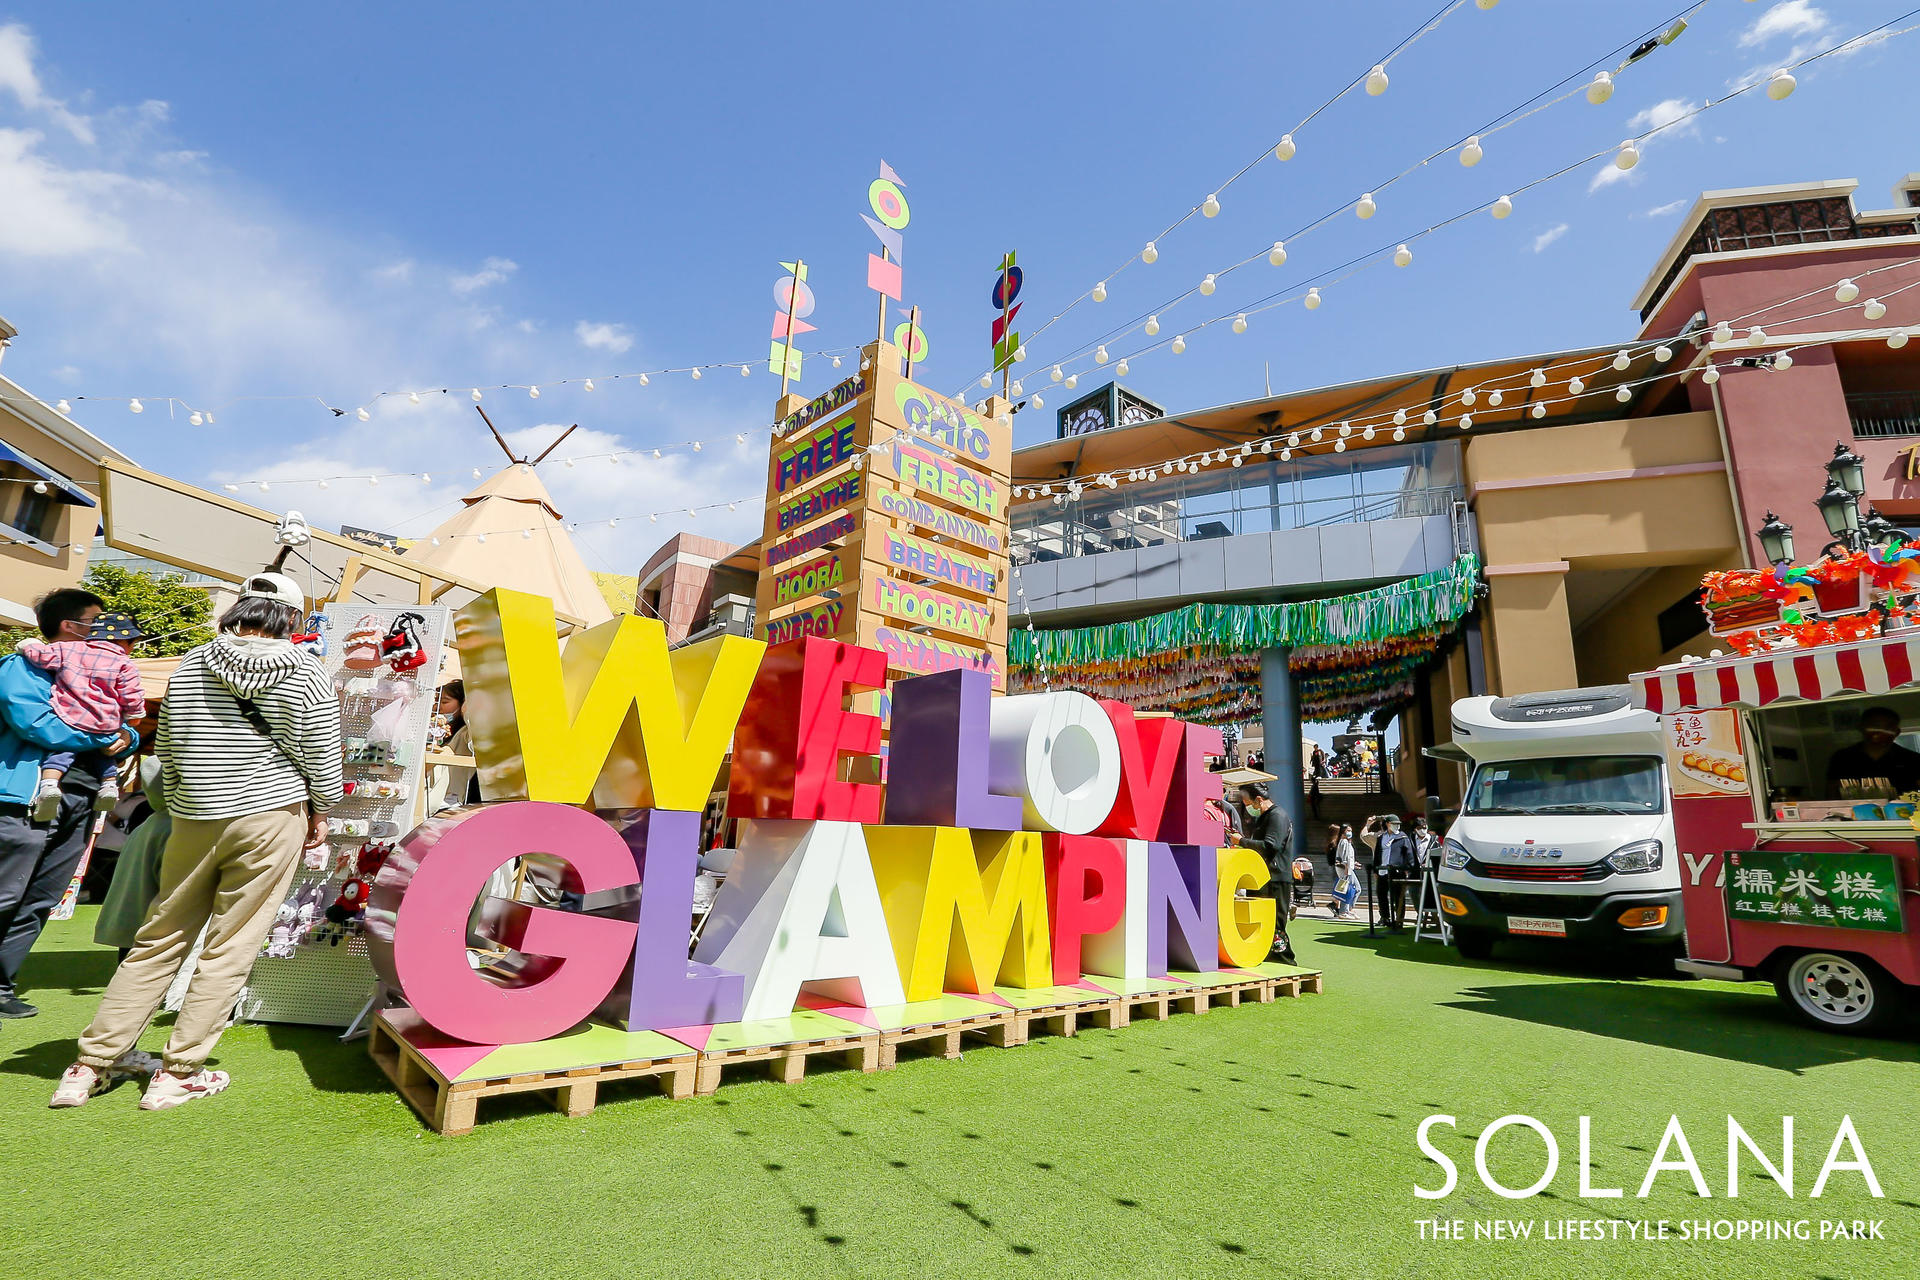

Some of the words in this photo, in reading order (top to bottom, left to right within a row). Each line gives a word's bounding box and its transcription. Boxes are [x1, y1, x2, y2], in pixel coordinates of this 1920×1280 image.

[895, 383, 991, 461] CHIC
[775, 416, 857, 493] FREE
[893, 442, 998, 516] FRESH
[777, 471, 861, 531] BREATHE
[877, 488, 999, 550] COMPANYING
[775, 555, 844, 604] HOORA
[884, 530, 997, 594] BREATHE
[764, 601, 844, 646] ENERGY
[875, 577, 991, 637] HOORAY
[456, 587, 888, 822] WE
[890, 669, 1225, 847] LOVE
[1733, 867, 1884, 900] 糯米糕
[1735, 899, 1802, 917] 红豆糕
[1811, 903, 1888, 923] 桂花糕
[366, 800, 1277, 1046] GLAMPING
